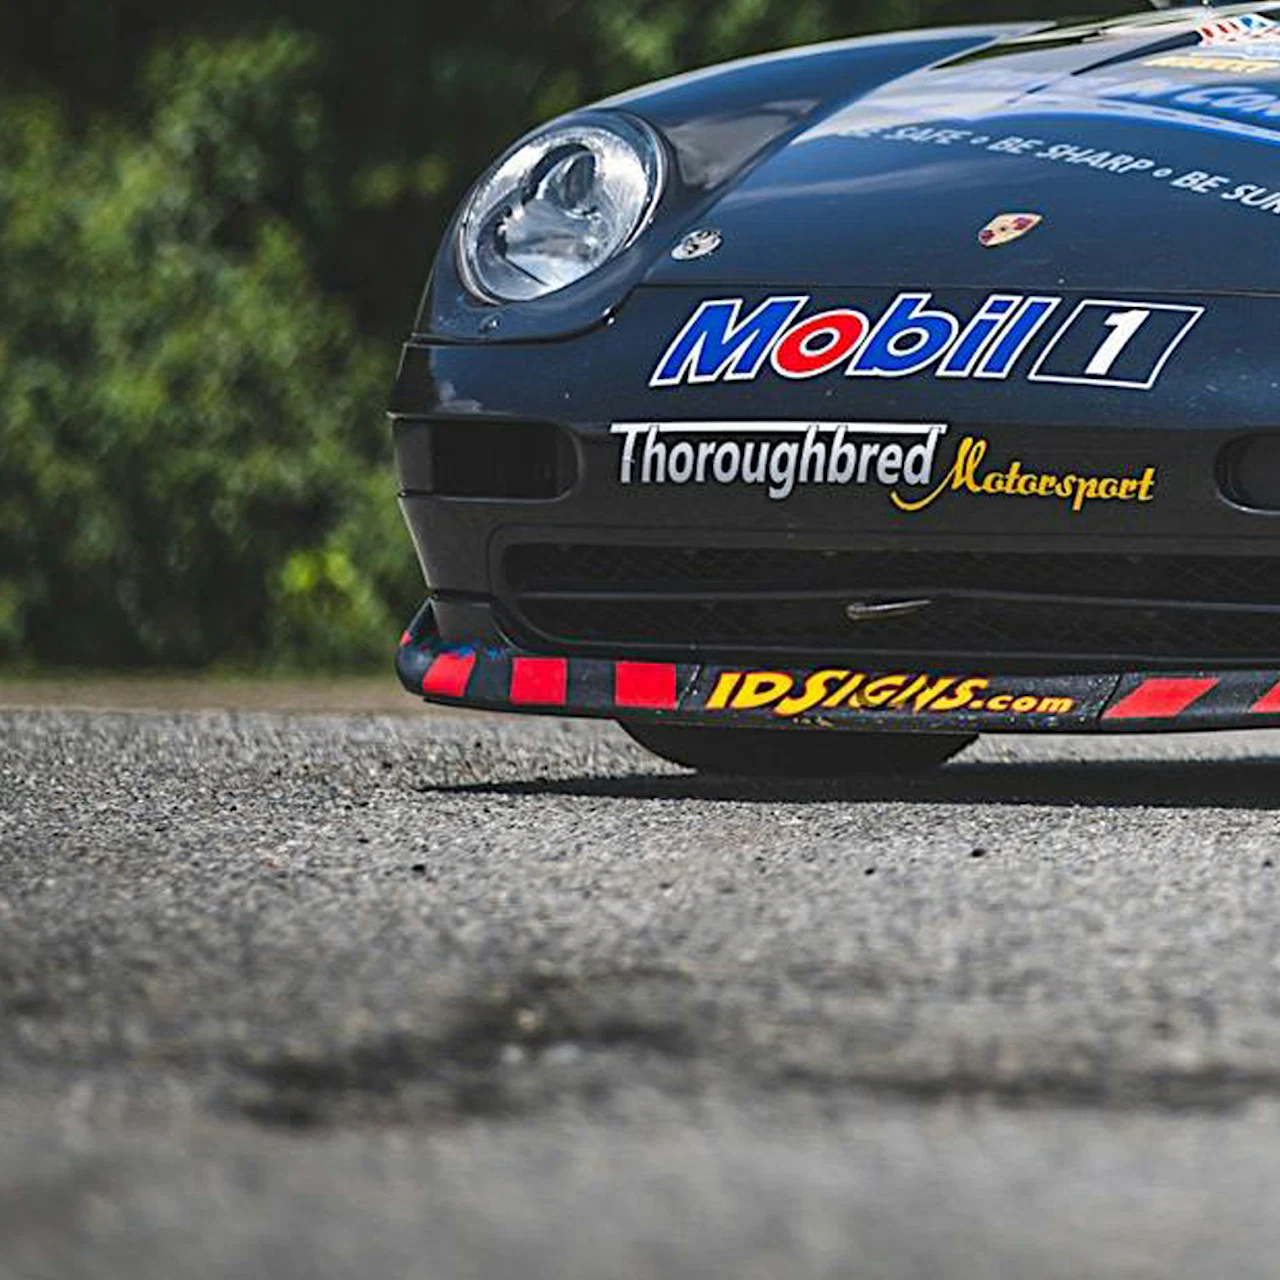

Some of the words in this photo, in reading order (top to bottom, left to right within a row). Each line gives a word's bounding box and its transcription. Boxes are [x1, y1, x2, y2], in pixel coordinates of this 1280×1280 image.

[883, 126, 972, 145] SAFE
[987, 135, 1044, 154] BE
[1036, 143, 1156, 178] SHARP
[1171, 170, 1228, 195] BE
[649, 293, 1062, 386] Mobil
[610, 422, 948, 500] Thoroughbred
[891, 437, 1154, 511] Motorsport
